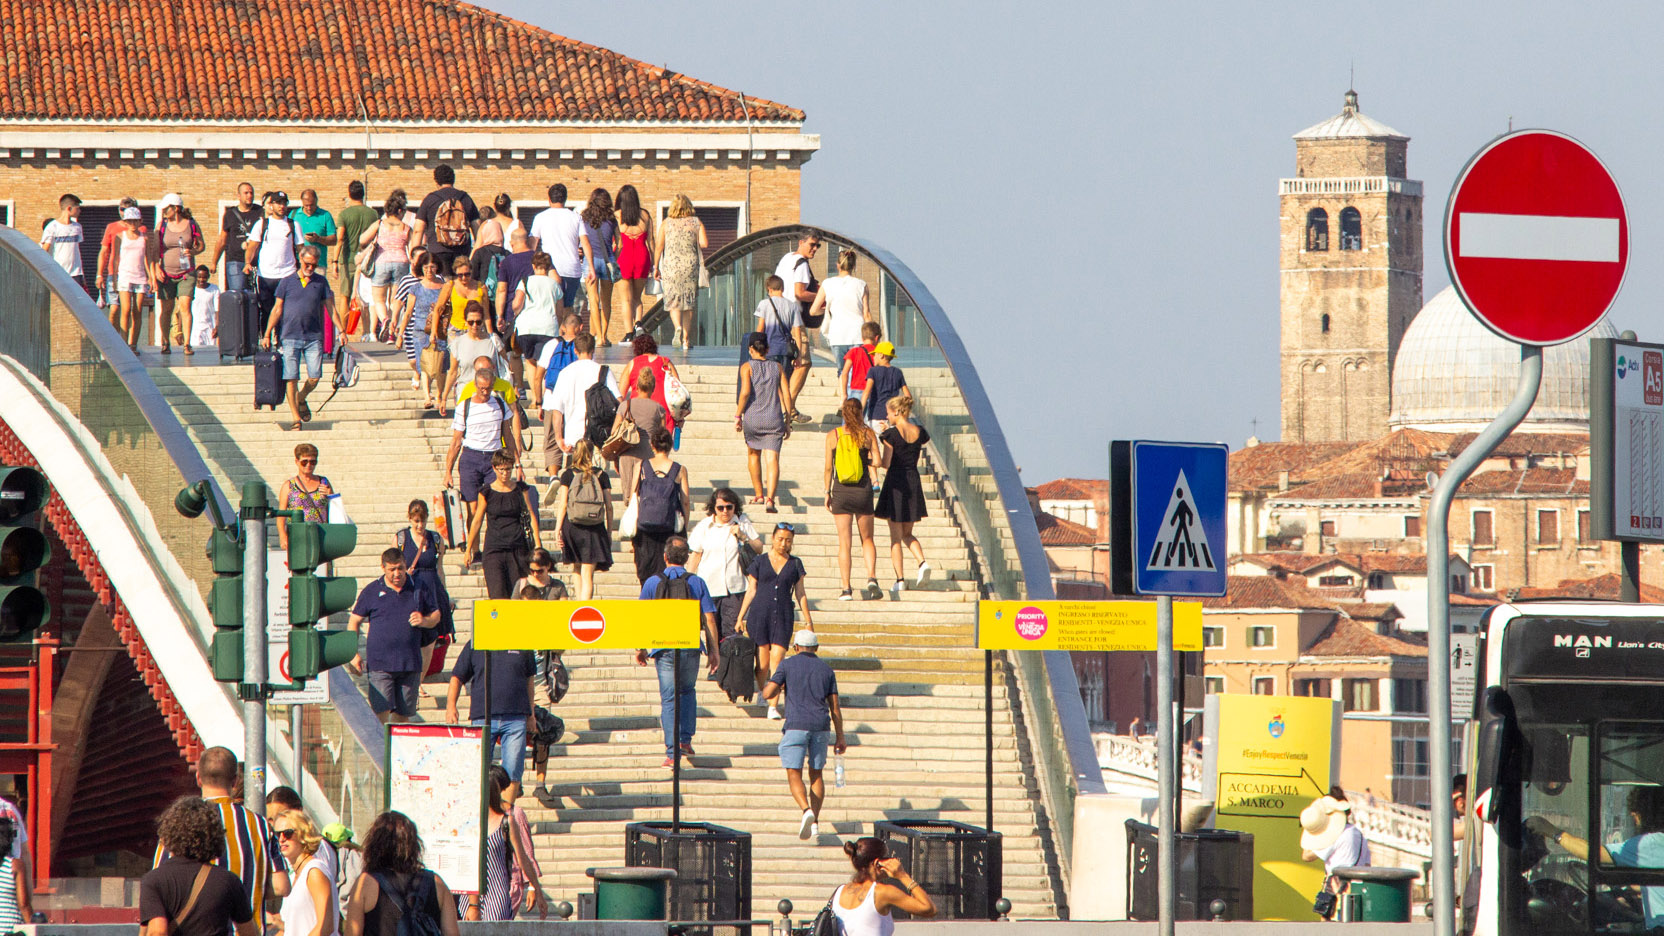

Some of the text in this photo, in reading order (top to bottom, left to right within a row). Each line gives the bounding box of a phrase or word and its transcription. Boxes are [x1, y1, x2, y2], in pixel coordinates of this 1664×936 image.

[1645, 365, 1662, 393] A5
[1018, 621, 1045, 631] VENEZIA
[1554, 634, 1612, 648] MAN
[1242, 749, 1308, 761] #EnjoyRespectVenezia
[1227, 783, 1299, 796] ACCADEMIA
[1227, 796, 1285, 809] S. MARCO
